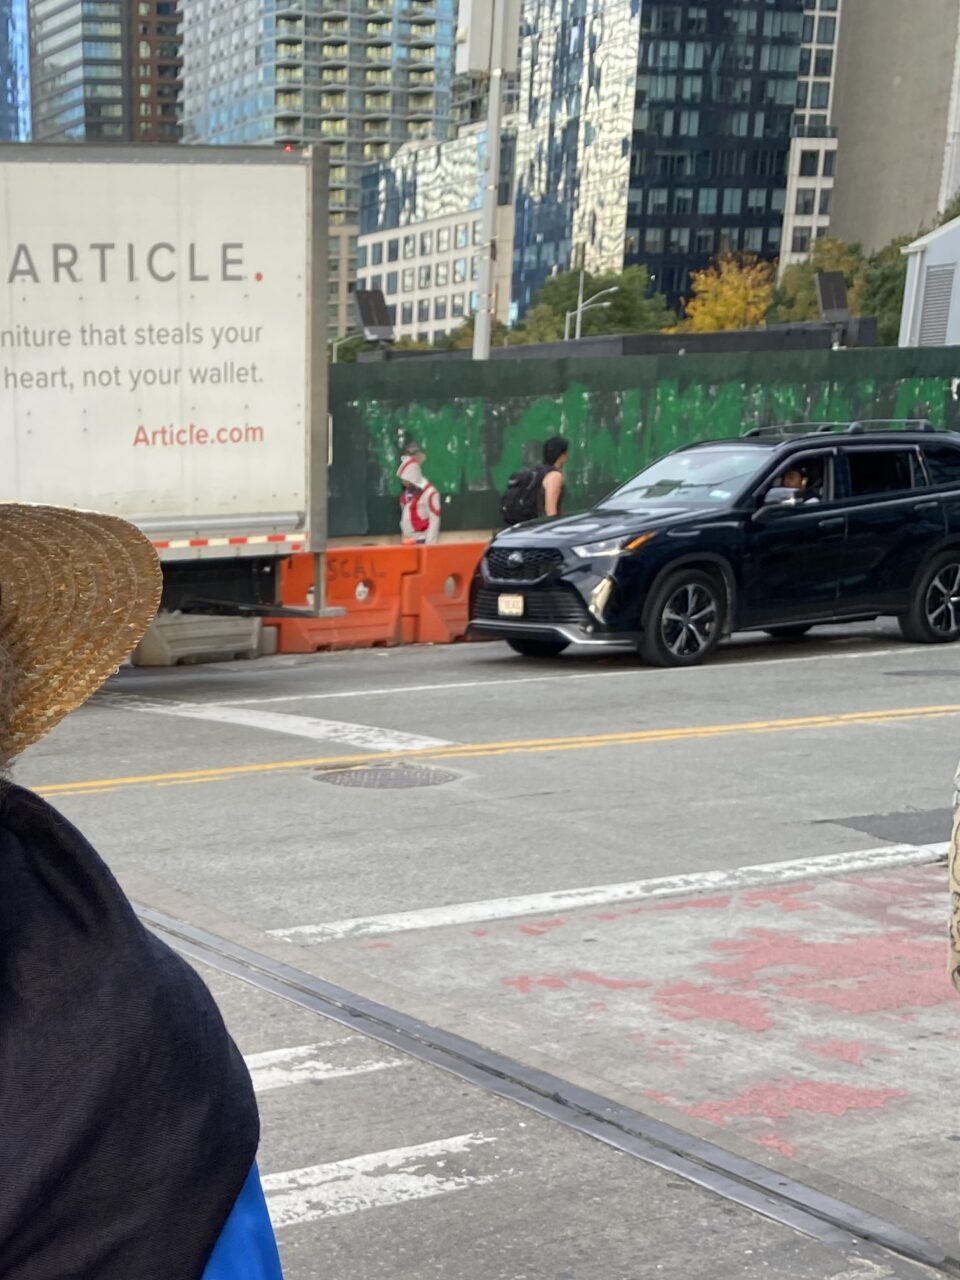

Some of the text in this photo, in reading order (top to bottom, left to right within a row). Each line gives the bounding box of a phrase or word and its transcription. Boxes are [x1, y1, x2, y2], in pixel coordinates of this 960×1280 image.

[7, 242, 263, 283] ARTICLE.
[80, 323, 127, 346] that
[134, 321, 203, 346] steals
[211, 323, 263, 349] your
[4, 361, 264, 391] heart, not your wallet.
[133, 424, 264, 446] Article.com
